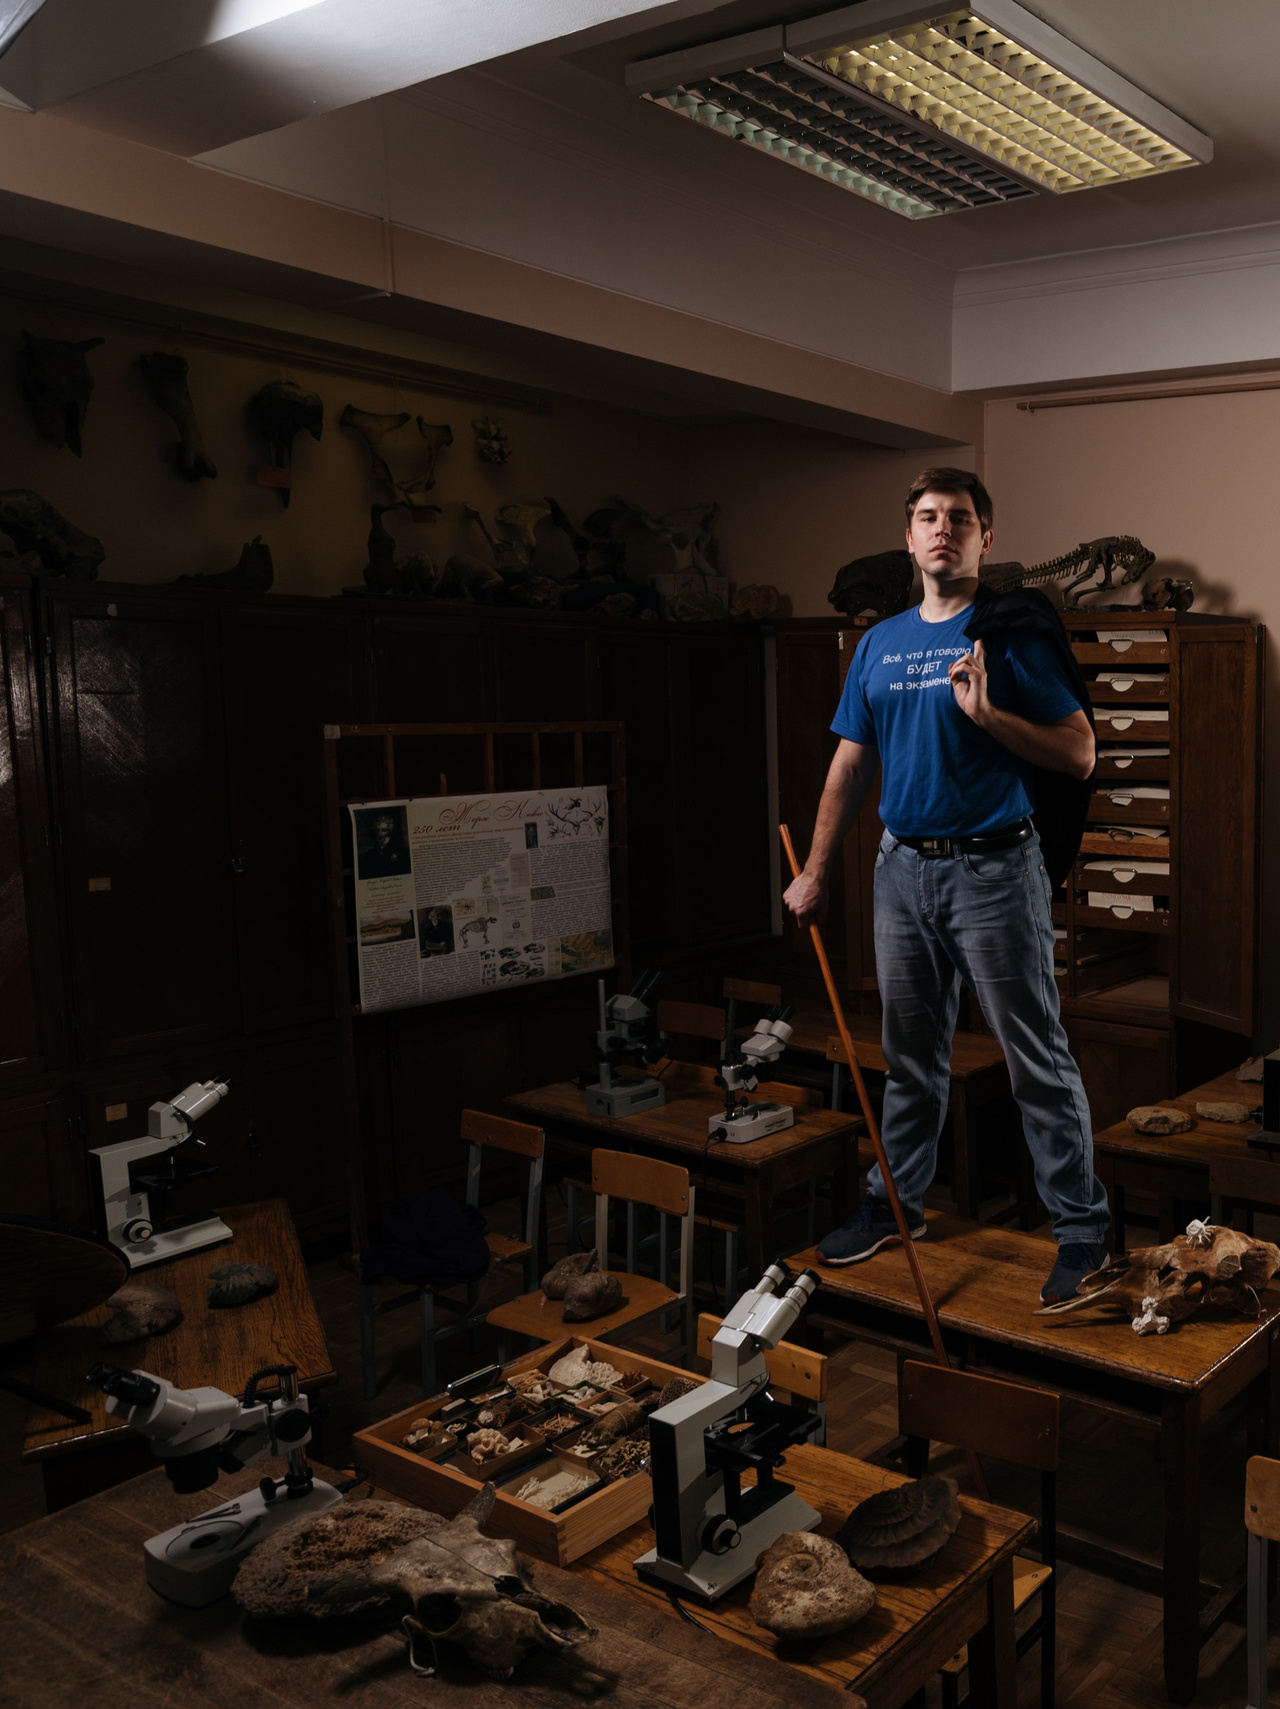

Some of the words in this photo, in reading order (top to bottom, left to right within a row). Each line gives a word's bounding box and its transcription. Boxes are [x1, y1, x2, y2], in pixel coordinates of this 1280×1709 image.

[882, 653, 903, 665] Всё,
[906, 650, 923, 661] что
[926, 650, 932, 658] я
[906, 661, 942, 676] БУДЕТ
[889, 680, 903, 692] на
[906, 676, 951, 690] экзамене
[413, 825, 433, 835] 250
[435, 825, 461, 833] лет
